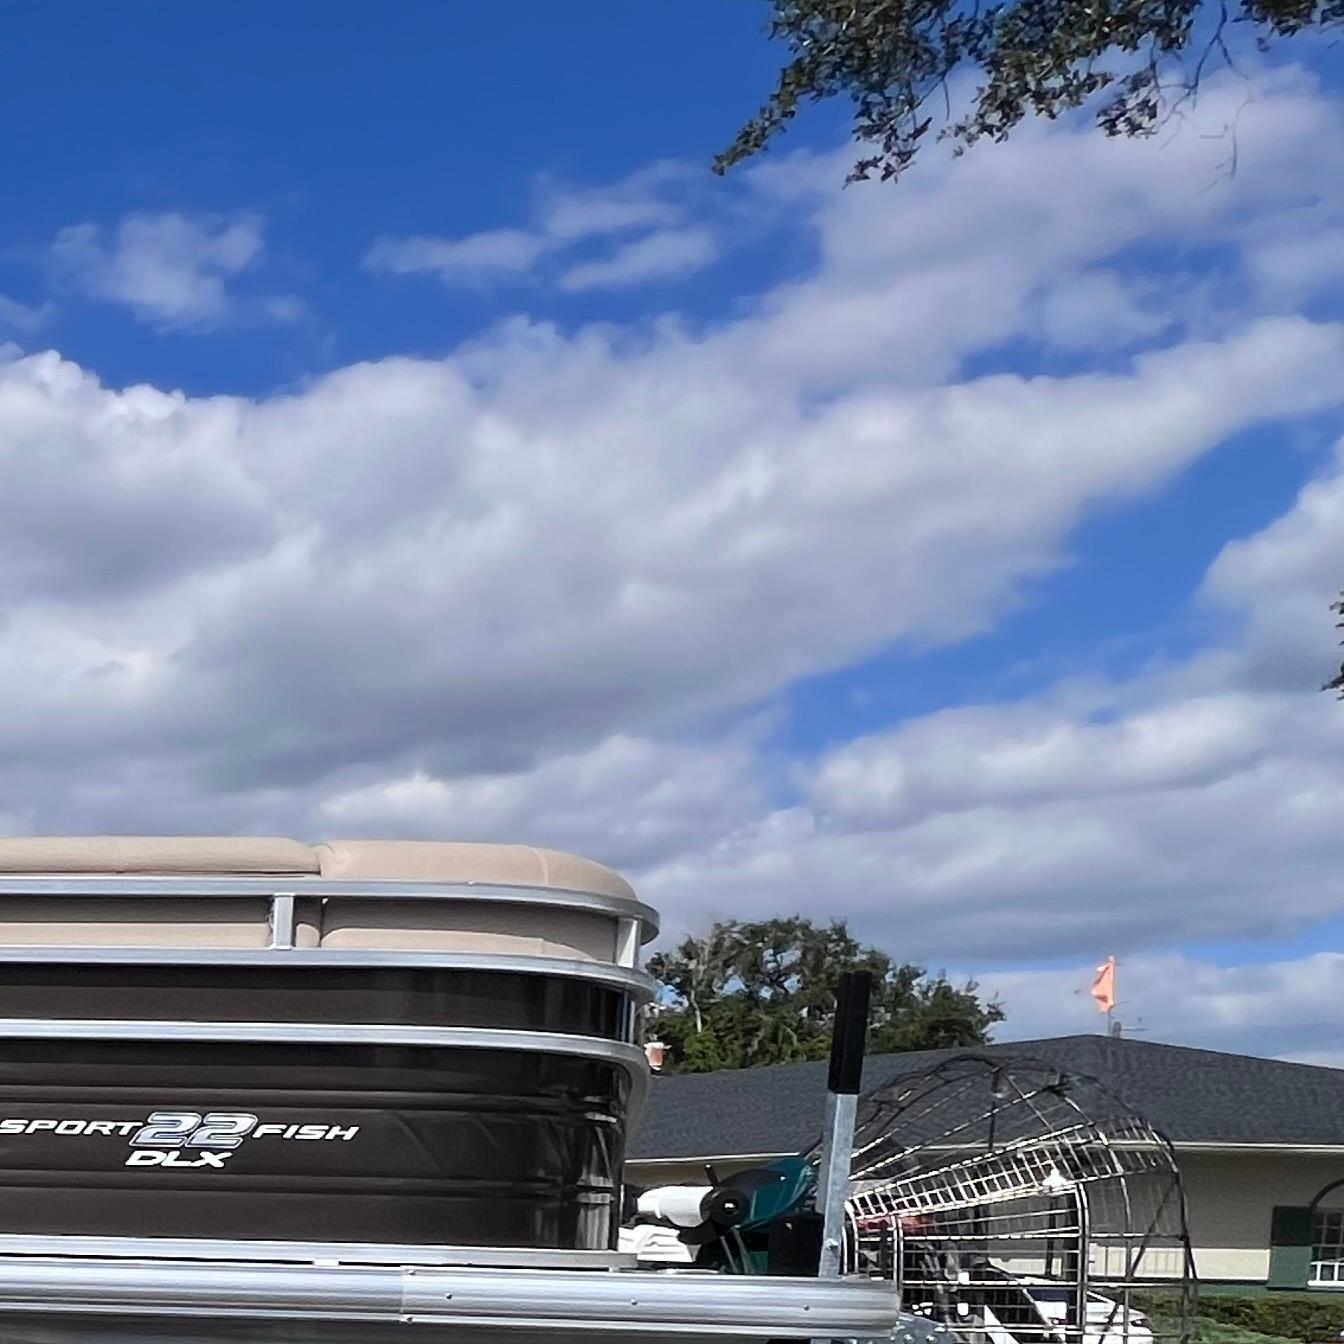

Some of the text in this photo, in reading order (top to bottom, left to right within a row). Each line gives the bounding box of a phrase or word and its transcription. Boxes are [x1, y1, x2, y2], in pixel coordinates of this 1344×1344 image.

[128, 1111, 258, 1149] 22
[252, 1123, 361, 1141] FISH
[124, 1149, 234, 1168] DLX
